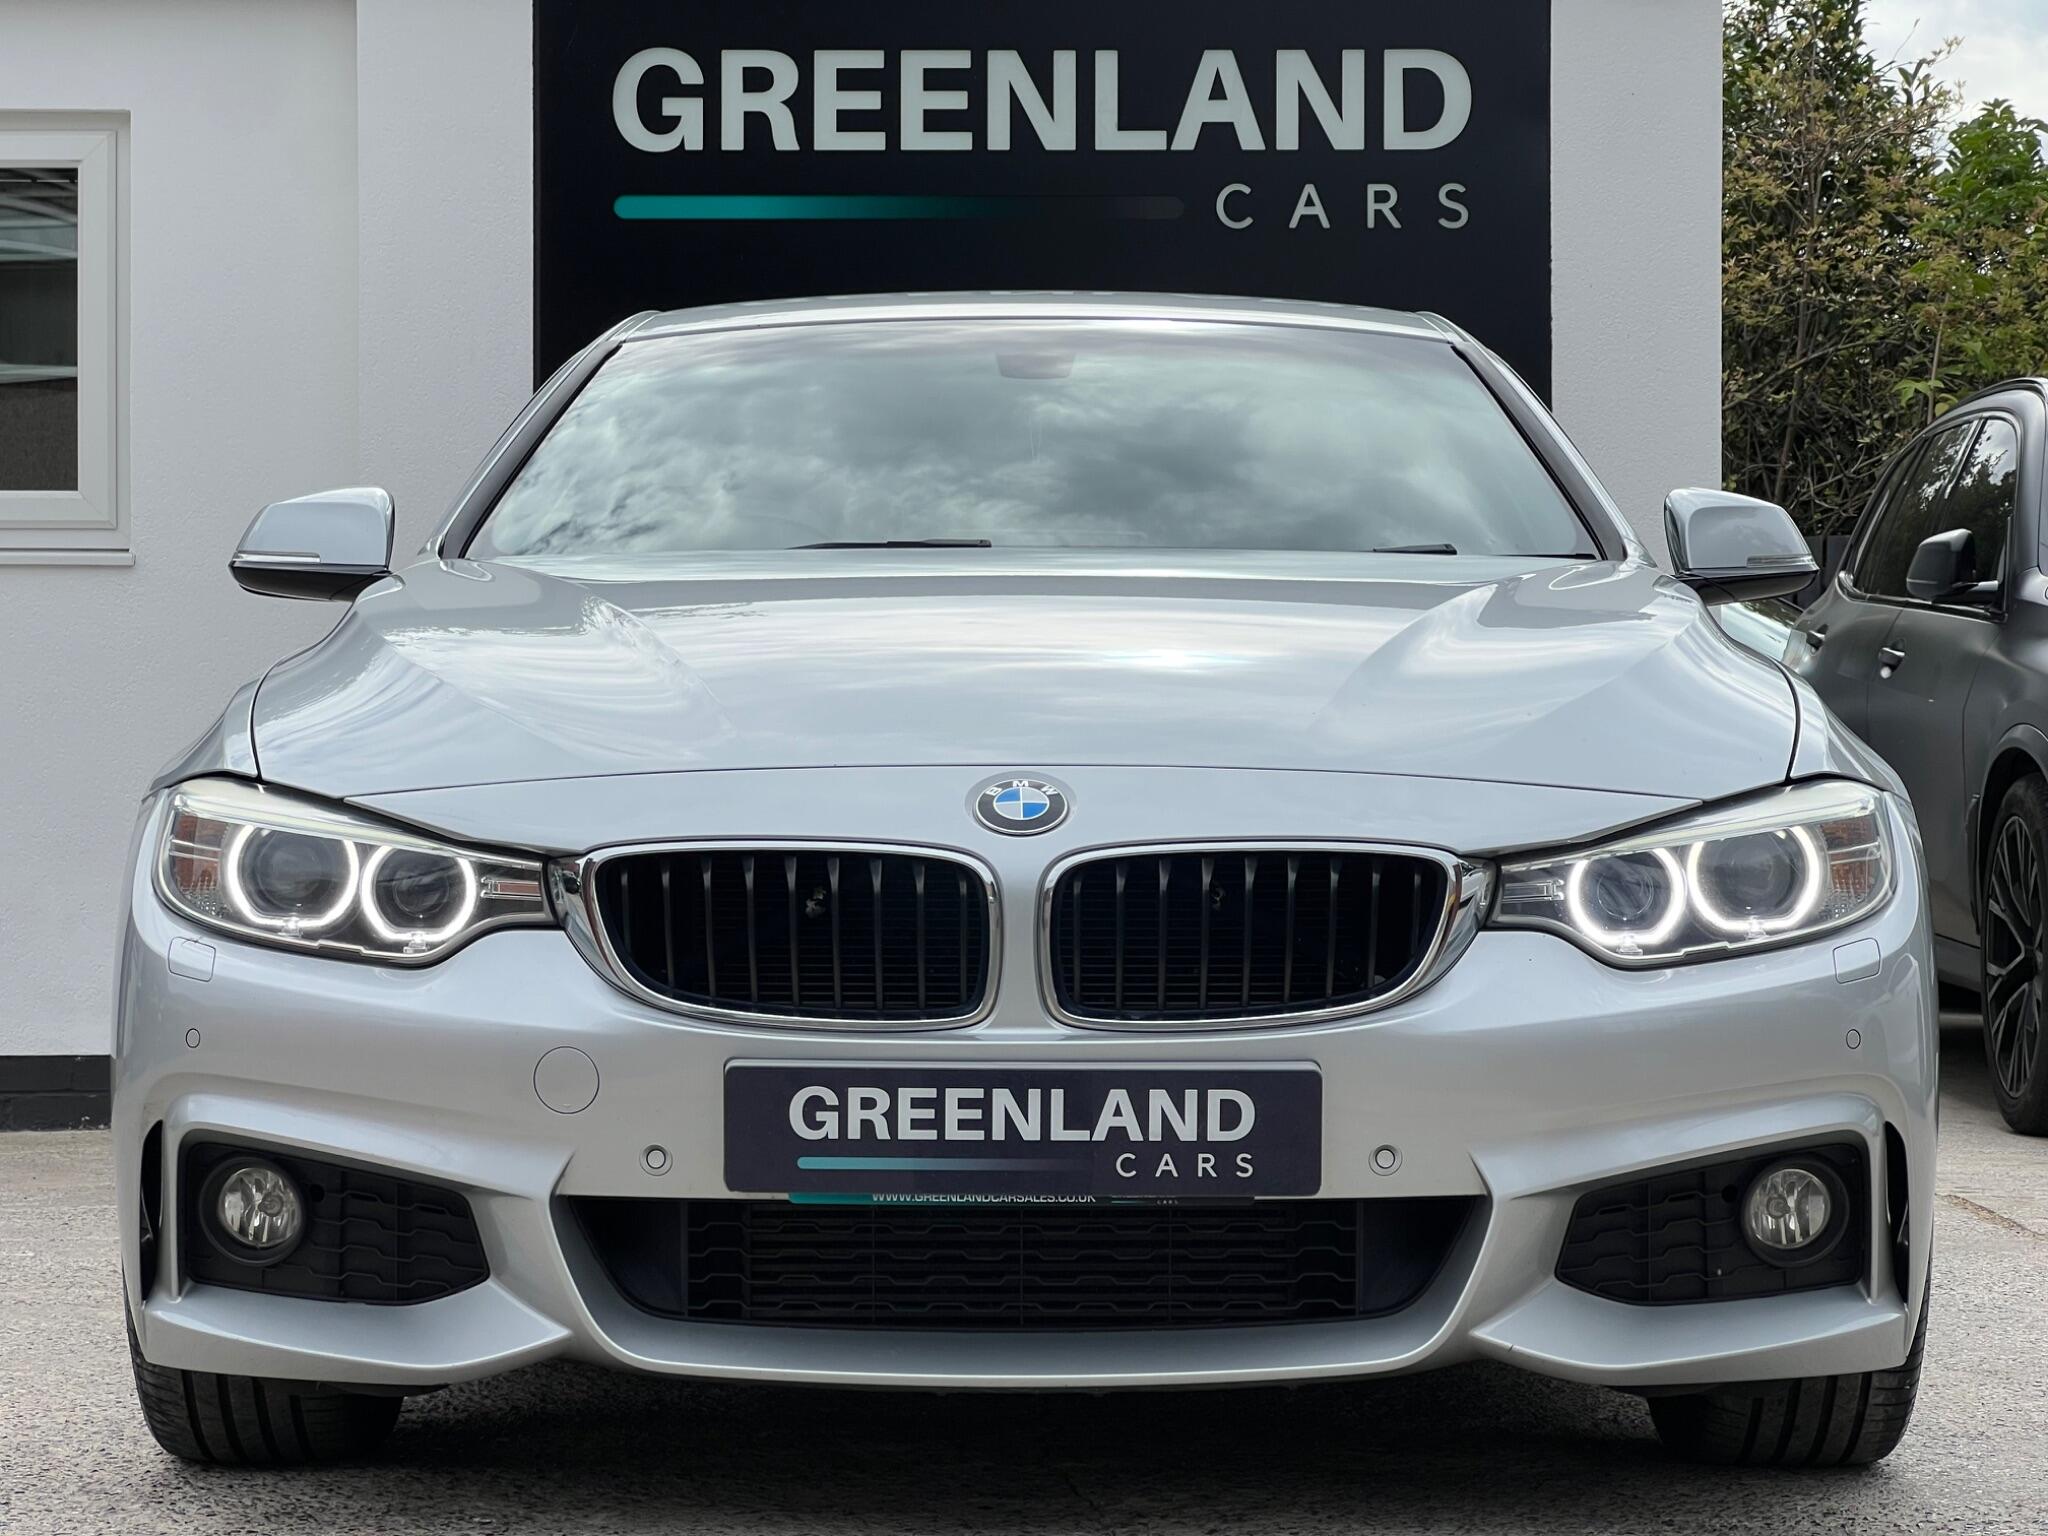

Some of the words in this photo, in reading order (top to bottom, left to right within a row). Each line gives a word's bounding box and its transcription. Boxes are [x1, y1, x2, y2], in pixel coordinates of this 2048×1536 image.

[612, 47, 1472, 152] GREENLAND
[1215, 183, 1471, 230] CARS
[986, 780, 1058, 796] BMW
[789, 1086, 1256, 1142] GREENLAND
[1115, 1153, 1254, 1178] CARS
